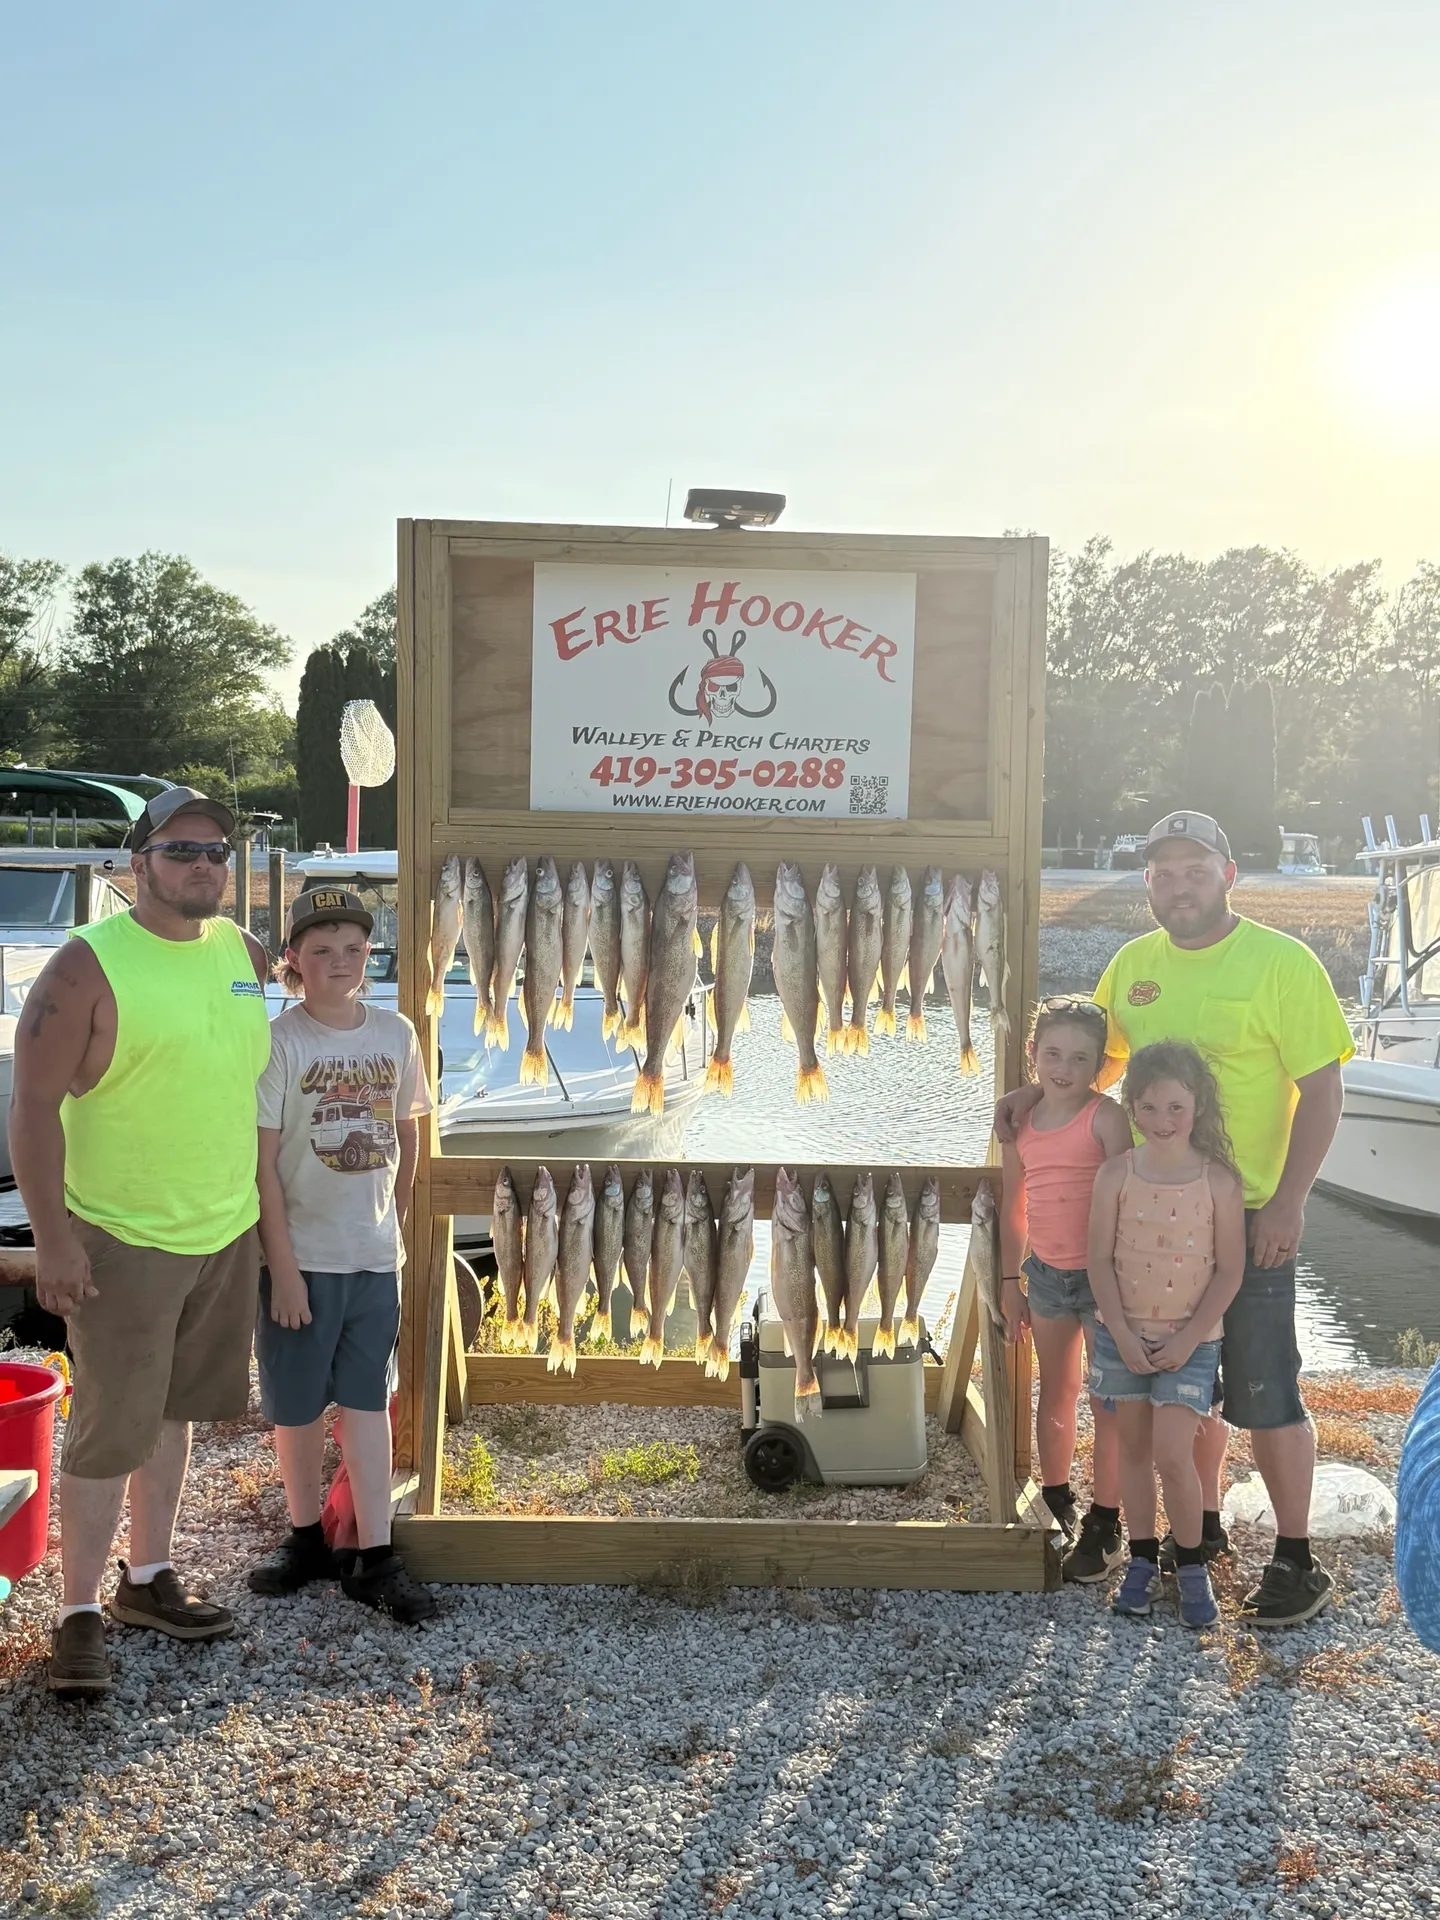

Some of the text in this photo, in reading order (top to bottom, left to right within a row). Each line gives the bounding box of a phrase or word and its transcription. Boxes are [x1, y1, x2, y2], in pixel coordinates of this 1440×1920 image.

[549, 581, 898, 683] ERIE HOOKER
[572, 726, 871, 755] WALLEYE & PERCH CHARTERS
[589, 755, 846, 790] 419-305-0288
[612, 793, 826, 813] WWW.ERIEHOOKER.COM
[315, 892, 345, 907] CAT
